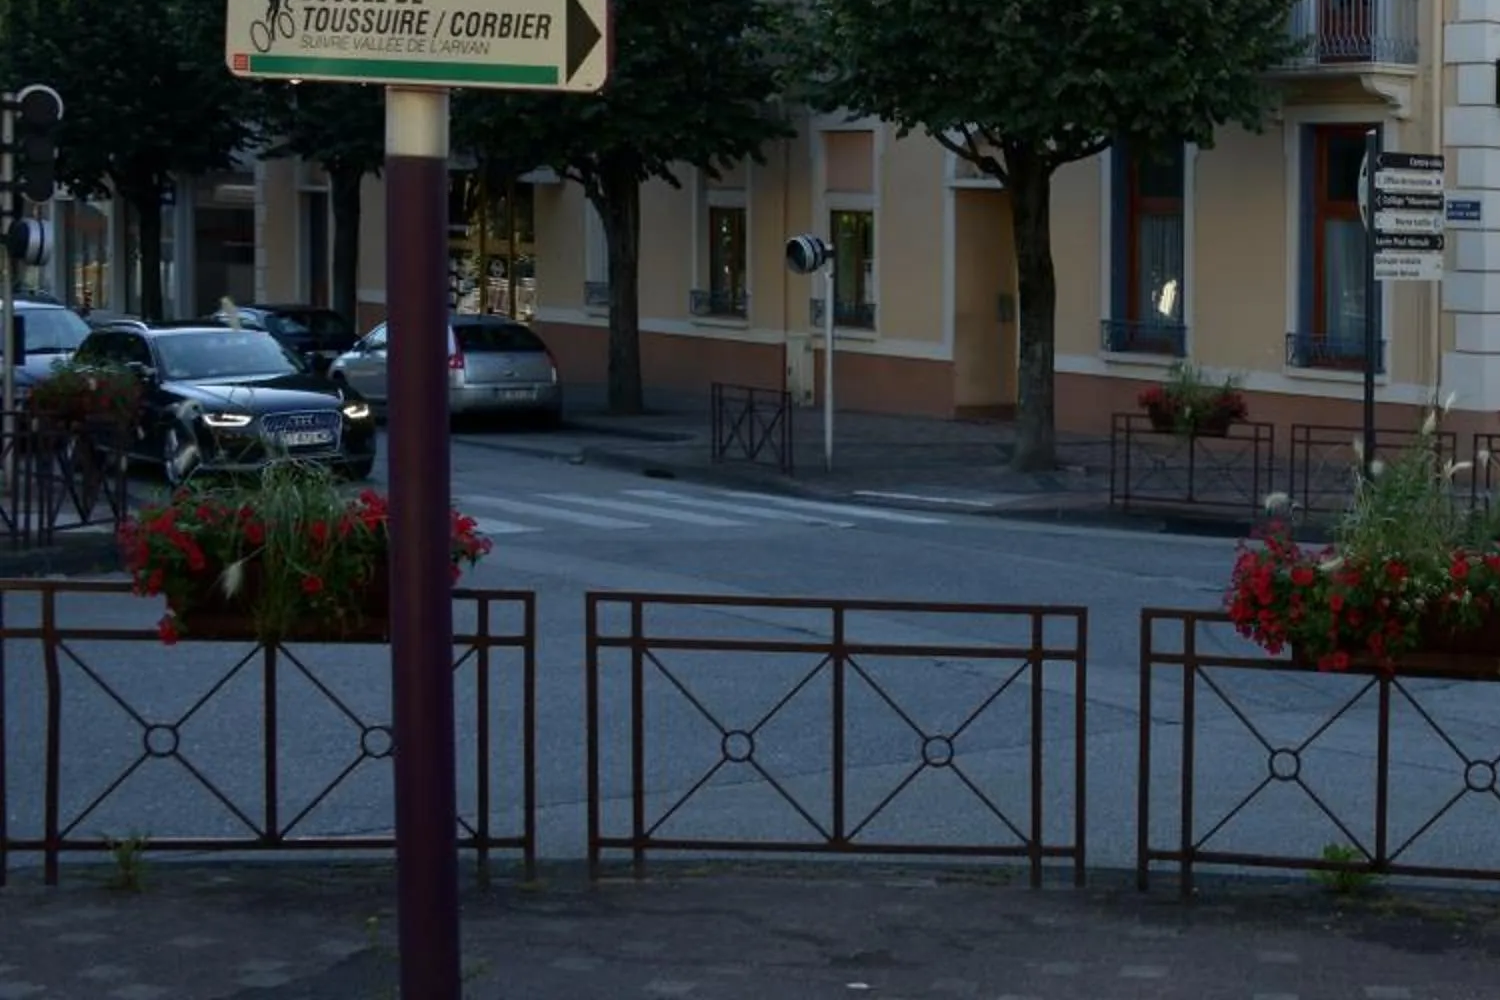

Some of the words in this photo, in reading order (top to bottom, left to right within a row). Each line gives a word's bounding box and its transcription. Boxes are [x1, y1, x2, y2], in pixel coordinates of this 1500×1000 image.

[303, 5, 431, 36] TOUSSUIRE
[449, 10, 553, 41] CORBIER
[407, 38, 427, 53] DE
[429, 39, 491, 55] L'ARVAN
